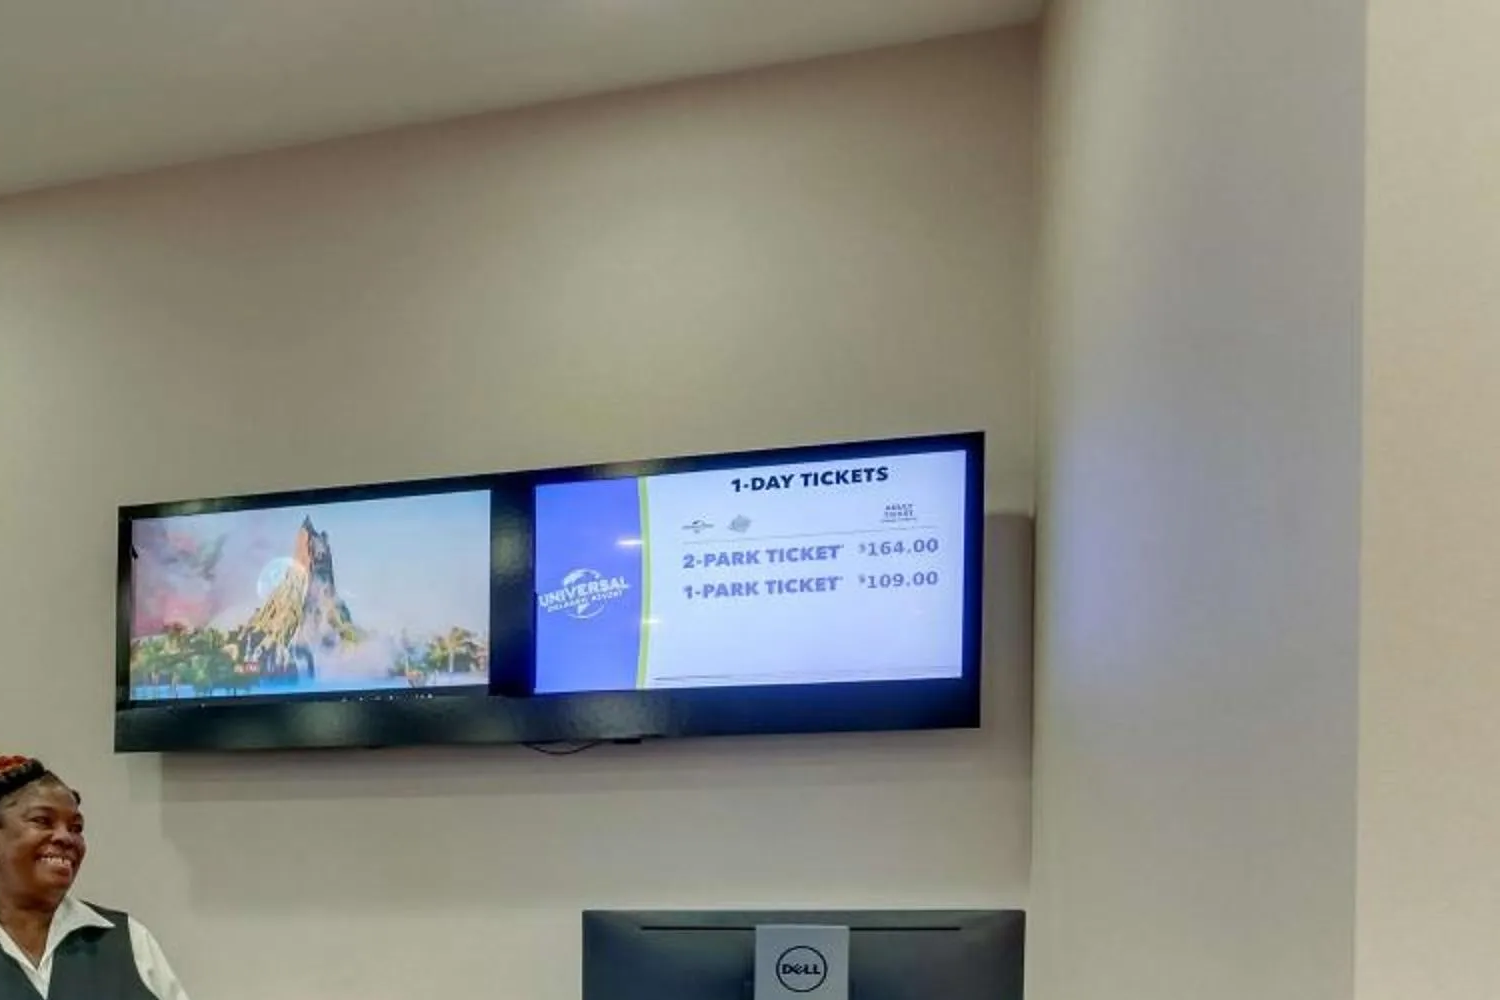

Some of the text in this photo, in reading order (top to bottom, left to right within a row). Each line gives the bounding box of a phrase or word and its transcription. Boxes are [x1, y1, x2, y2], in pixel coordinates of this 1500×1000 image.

[731, 466, 889, 493] 1-DAY TICKETS
[683, 550, 760, 569] 2-PARK
[538, 576, 628, 608] UNIVERSAL
[684, 581, 760, 600] 1-PARK
[782, 963, 821, 975] DELL
